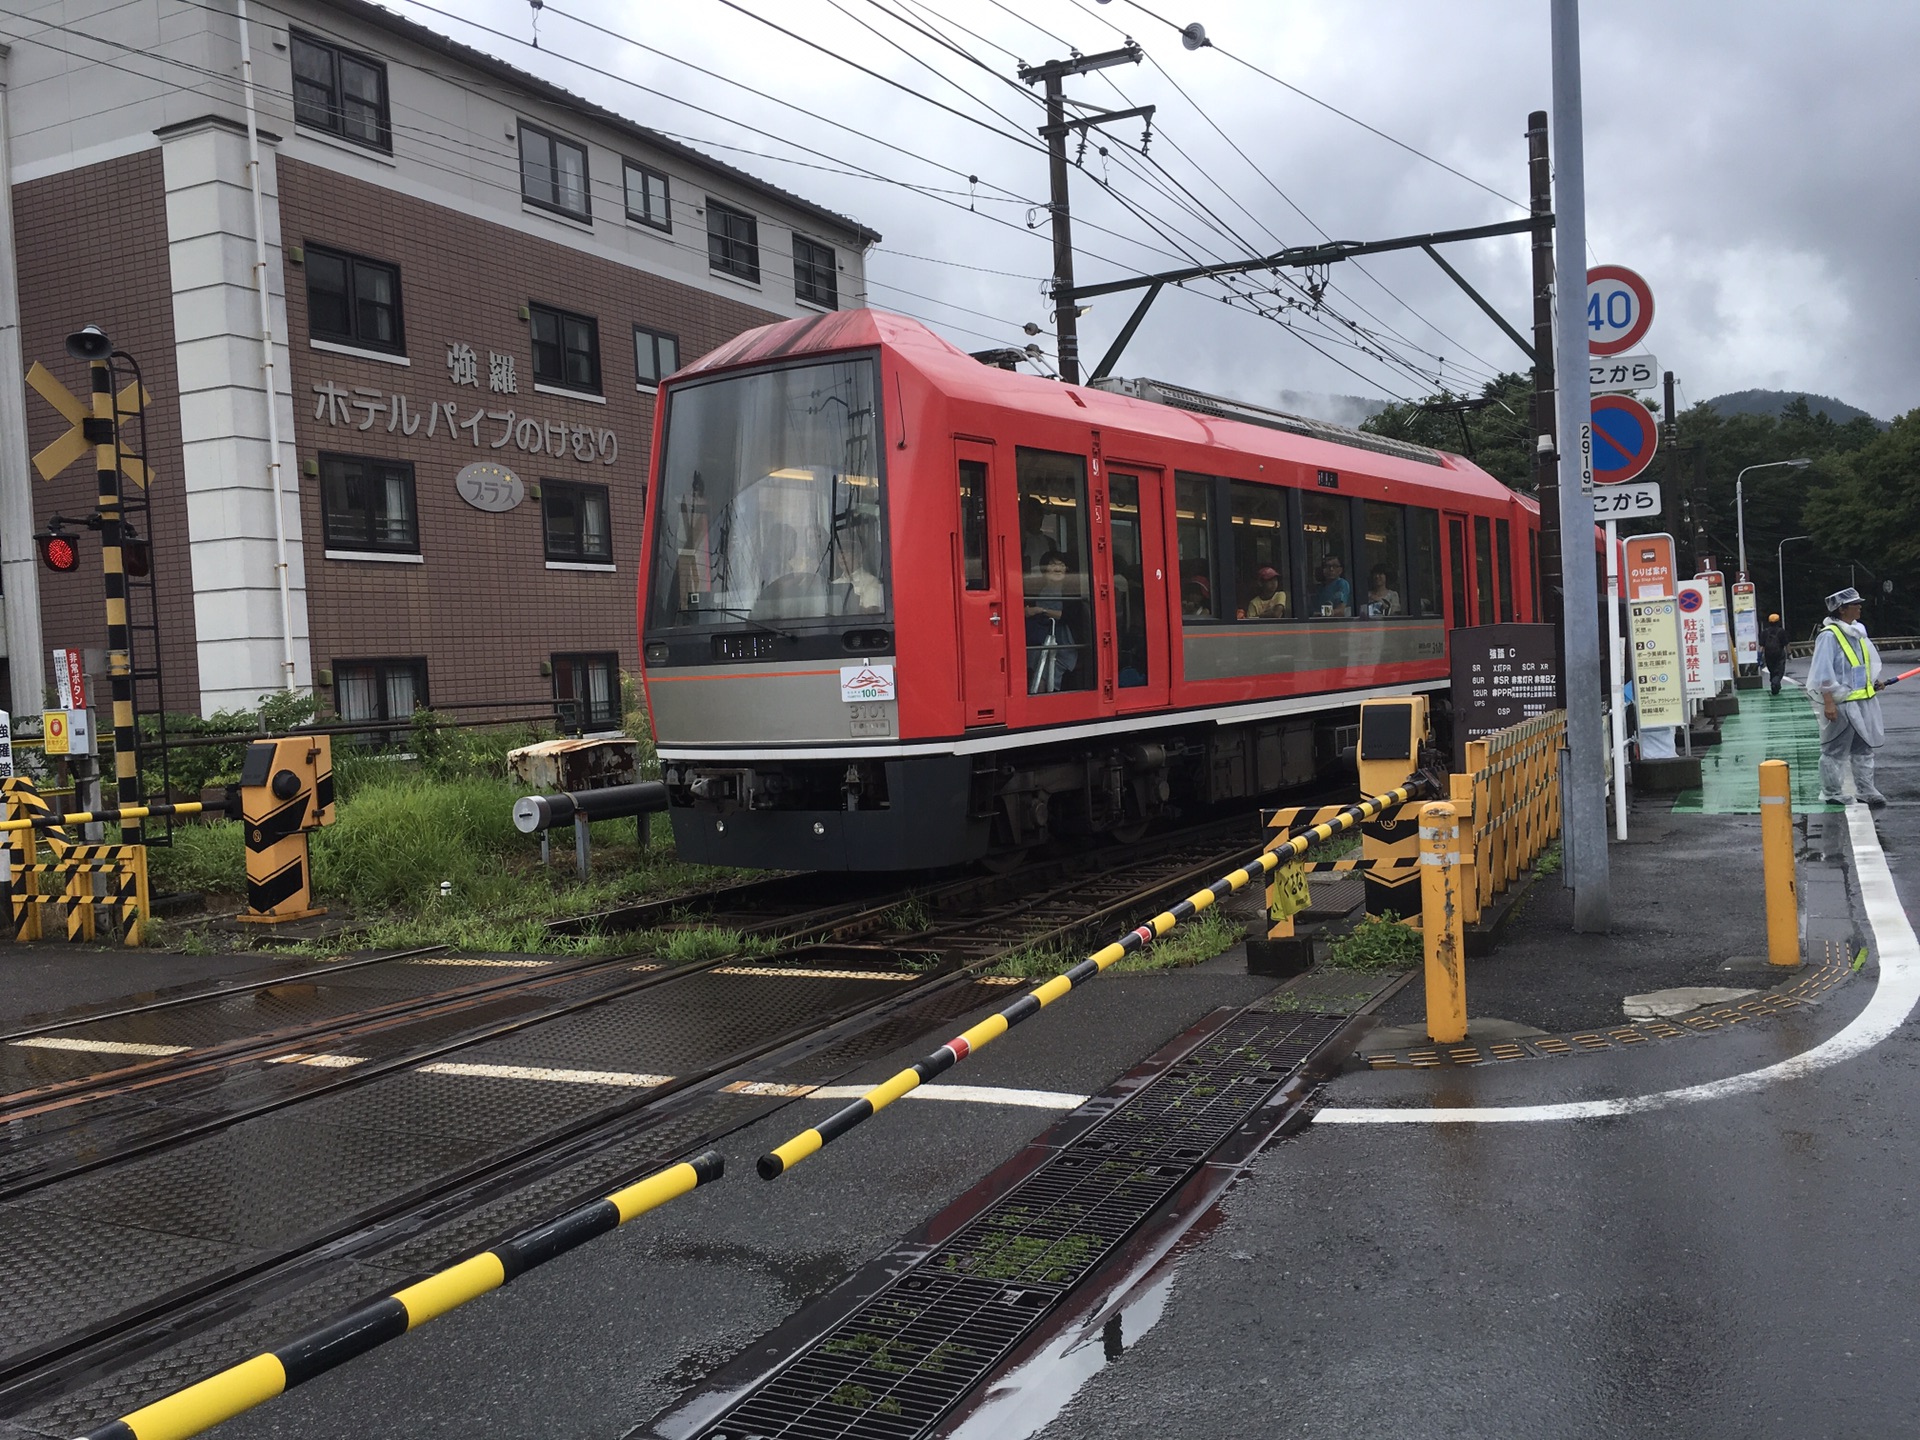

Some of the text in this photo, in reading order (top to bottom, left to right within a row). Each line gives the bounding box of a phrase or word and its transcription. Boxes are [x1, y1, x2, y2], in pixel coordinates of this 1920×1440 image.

[1587, 290, 1632, 331] 40
[446, 341, 519, 395] 強羅
[1581, 425, 1591, 485] 2919
[466, 479, 517, 506] プラス
[1631, 566, 1668, 577] のりば案内
[1509, 648, 1516, 658] C
[1684, 618, 1701, 683] 駐停車禁止
[68, 652, 83, 706] 非常ボタン
[1472, 664, 1481, 672] SR
[1521, 663, 1536, 671] SCR
[861, 689, 877, 698] 100
[850, 705, 885, 719] 3101
